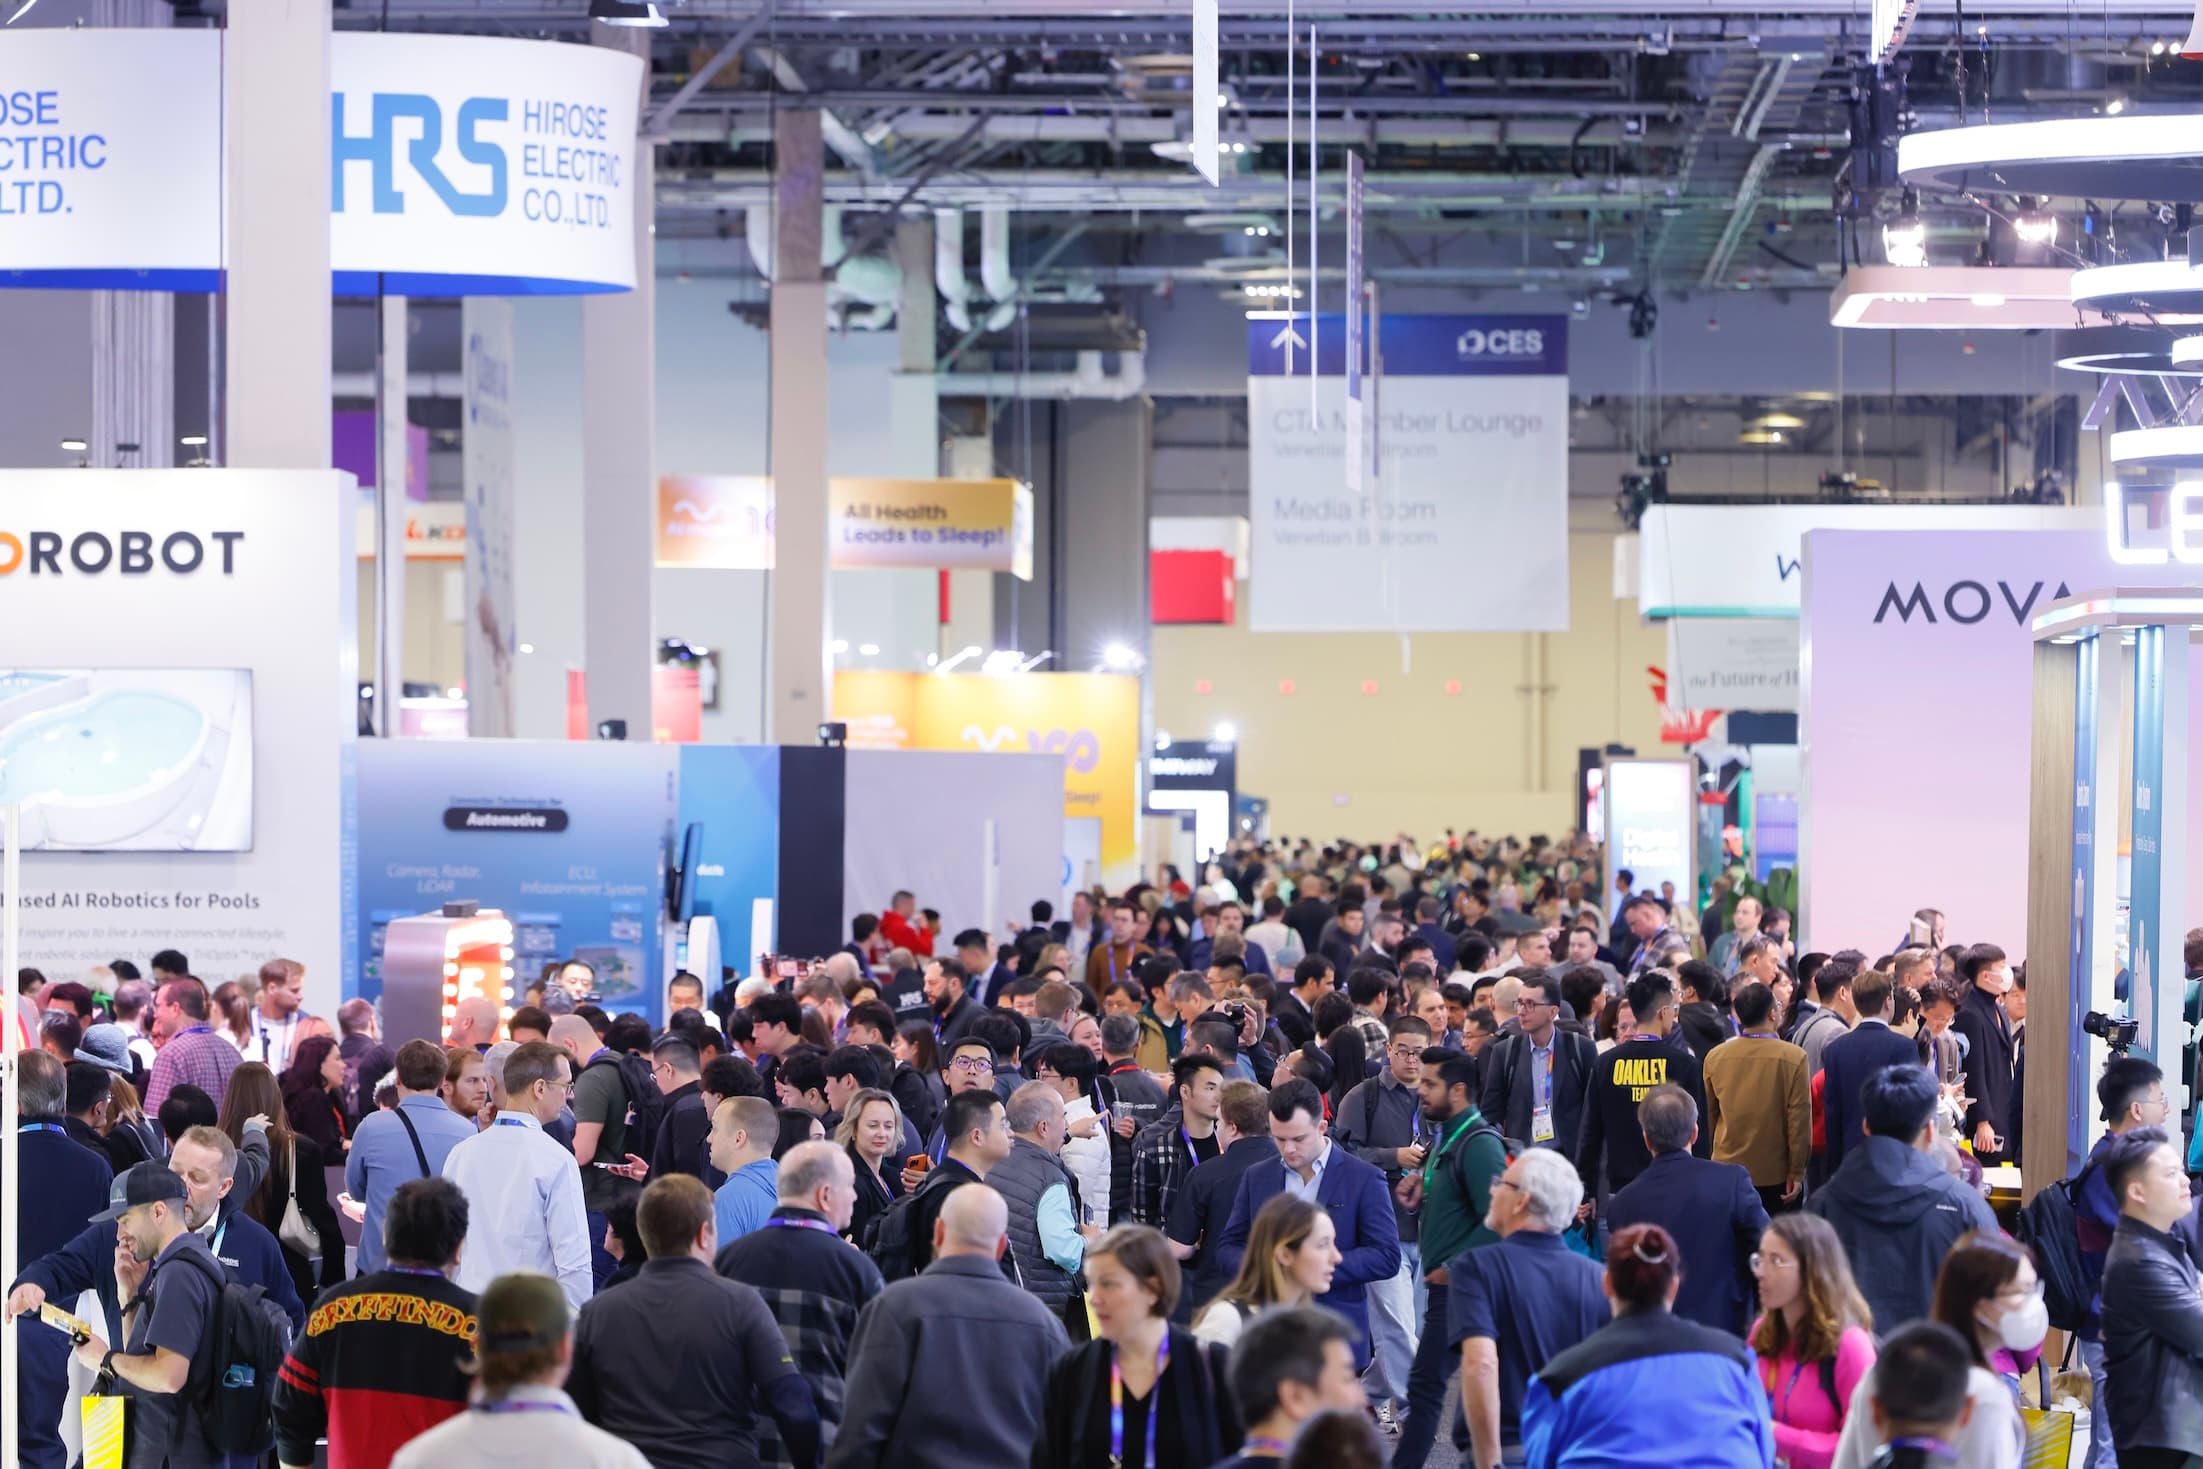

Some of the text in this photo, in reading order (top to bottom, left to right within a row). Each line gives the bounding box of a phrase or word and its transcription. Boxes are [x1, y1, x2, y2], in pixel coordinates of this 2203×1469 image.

[524, 99, 607, 140] HIROSE
[331, 92, 508, 217] HRS
[523, 144, 622, 188] ELECTRIC
[1488, 329, 1543, 354] CES
[1446, 409, 1543, 437] Lounge
[845, 505, 947, 520] All Health
[1274, 499, 1351, 521] Media
[843, 527, 1005, 549] Leads to Sleep!
[1711, 671, 1767, 687] Future
[466, 812, 546, 828] Automotive
[62, 893, 79, 908] AI
[86, 892, 168, 908] Robotics
[174, 892, 201, 908] for
[208, 893, 260, 909] Pools
[603, 883, 648, 898] System
[174, 927, 236, 938] connected
[1613, 1058, 1667, 1085] OAKLEY
[307, 1293, 480, 1358] GRYFFINDO
